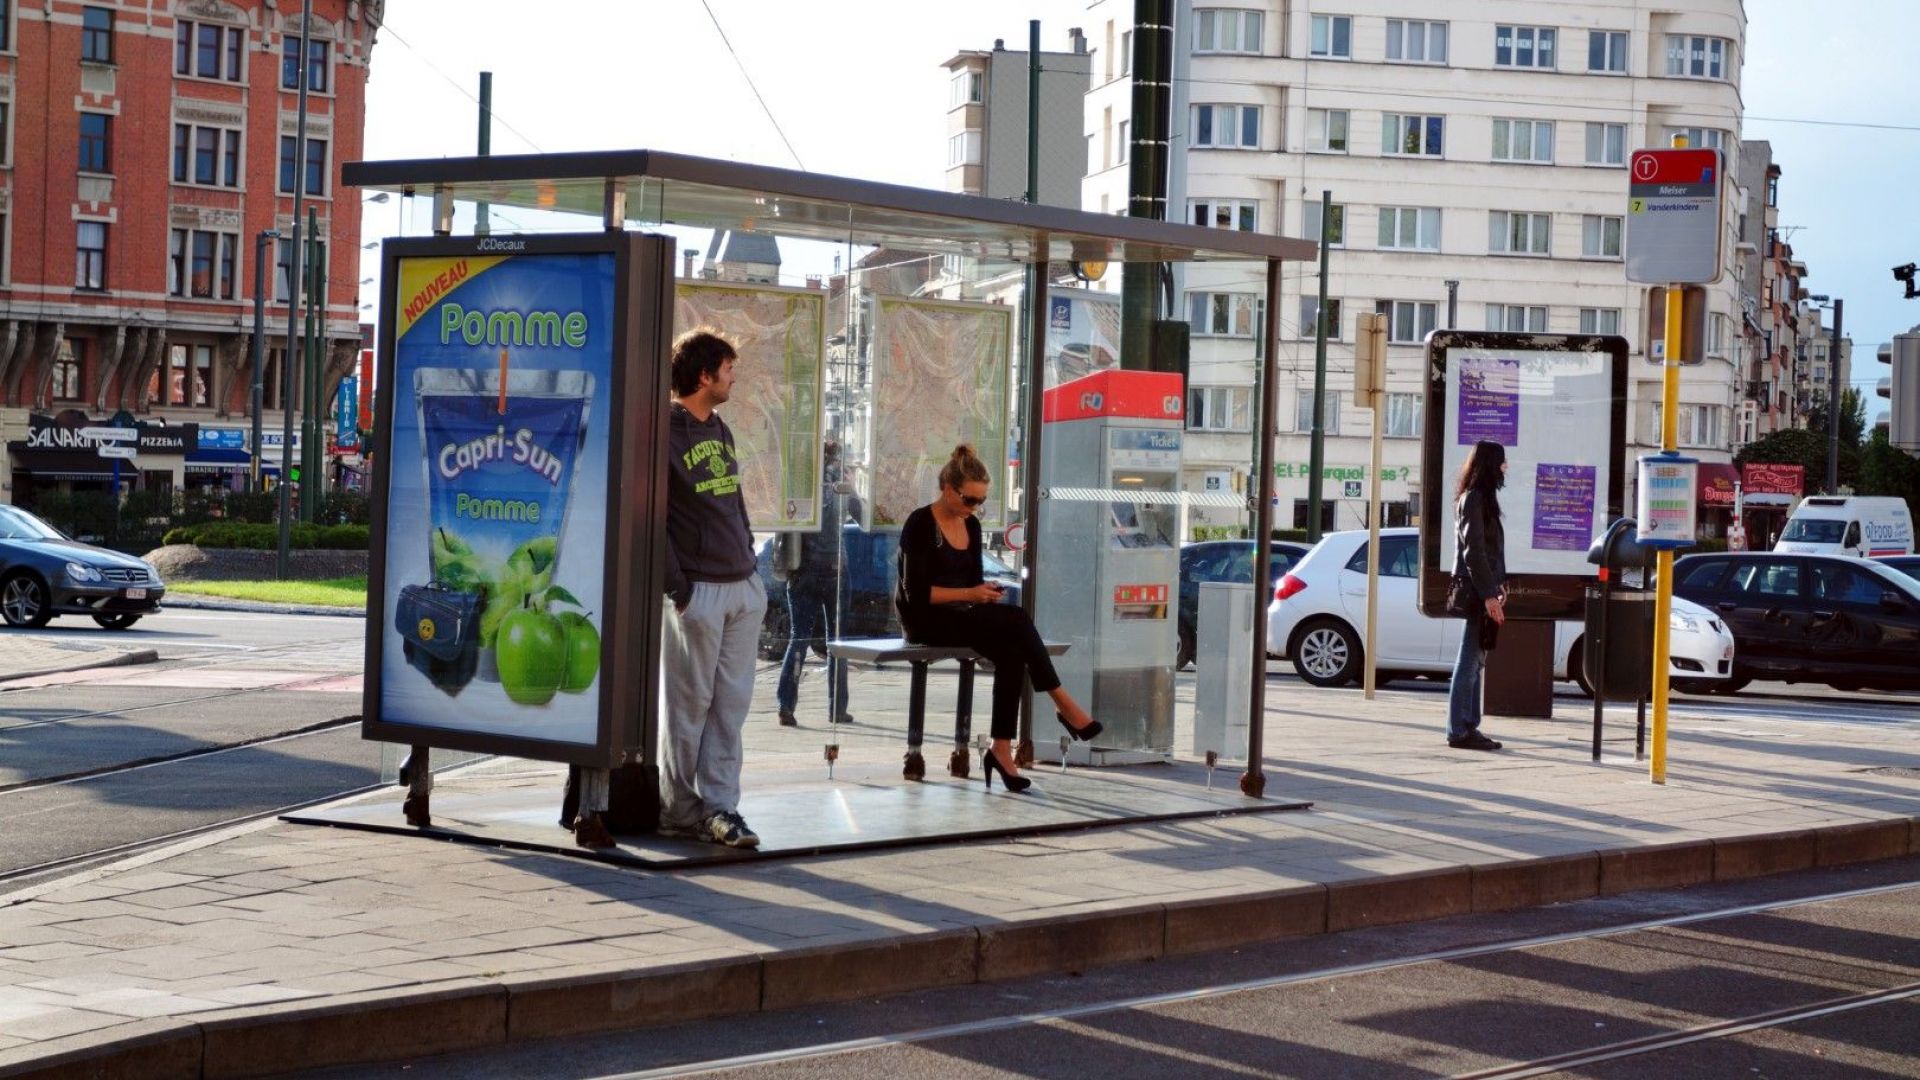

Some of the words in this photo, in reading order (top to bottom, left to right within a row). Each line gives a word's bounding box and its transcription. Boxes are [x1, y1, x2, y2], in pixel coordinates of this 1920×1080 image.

[1633, 200, 1641, 212] 7
[1646, 202, 1700, 212] Vanderkindere
[477, 238, 526, 251] JCDecaux
[404, 259, 469, 323] NOUVEAU
[441, 303, 588, 347] Pomme
[1163, 395, 1181, 414] GO
[140, 437, 183, 447] PIZZERIA
[1150, 434, 1177, 448] Ticket
[440, 424, 562, 484] Capri-Sun
[1275, 463, 1293, 478] Et
[1299, 464, 1364, 482] Purquoi
[1379, 468, 1397, 481] as
[456, 493, 540, 524] Pomme
